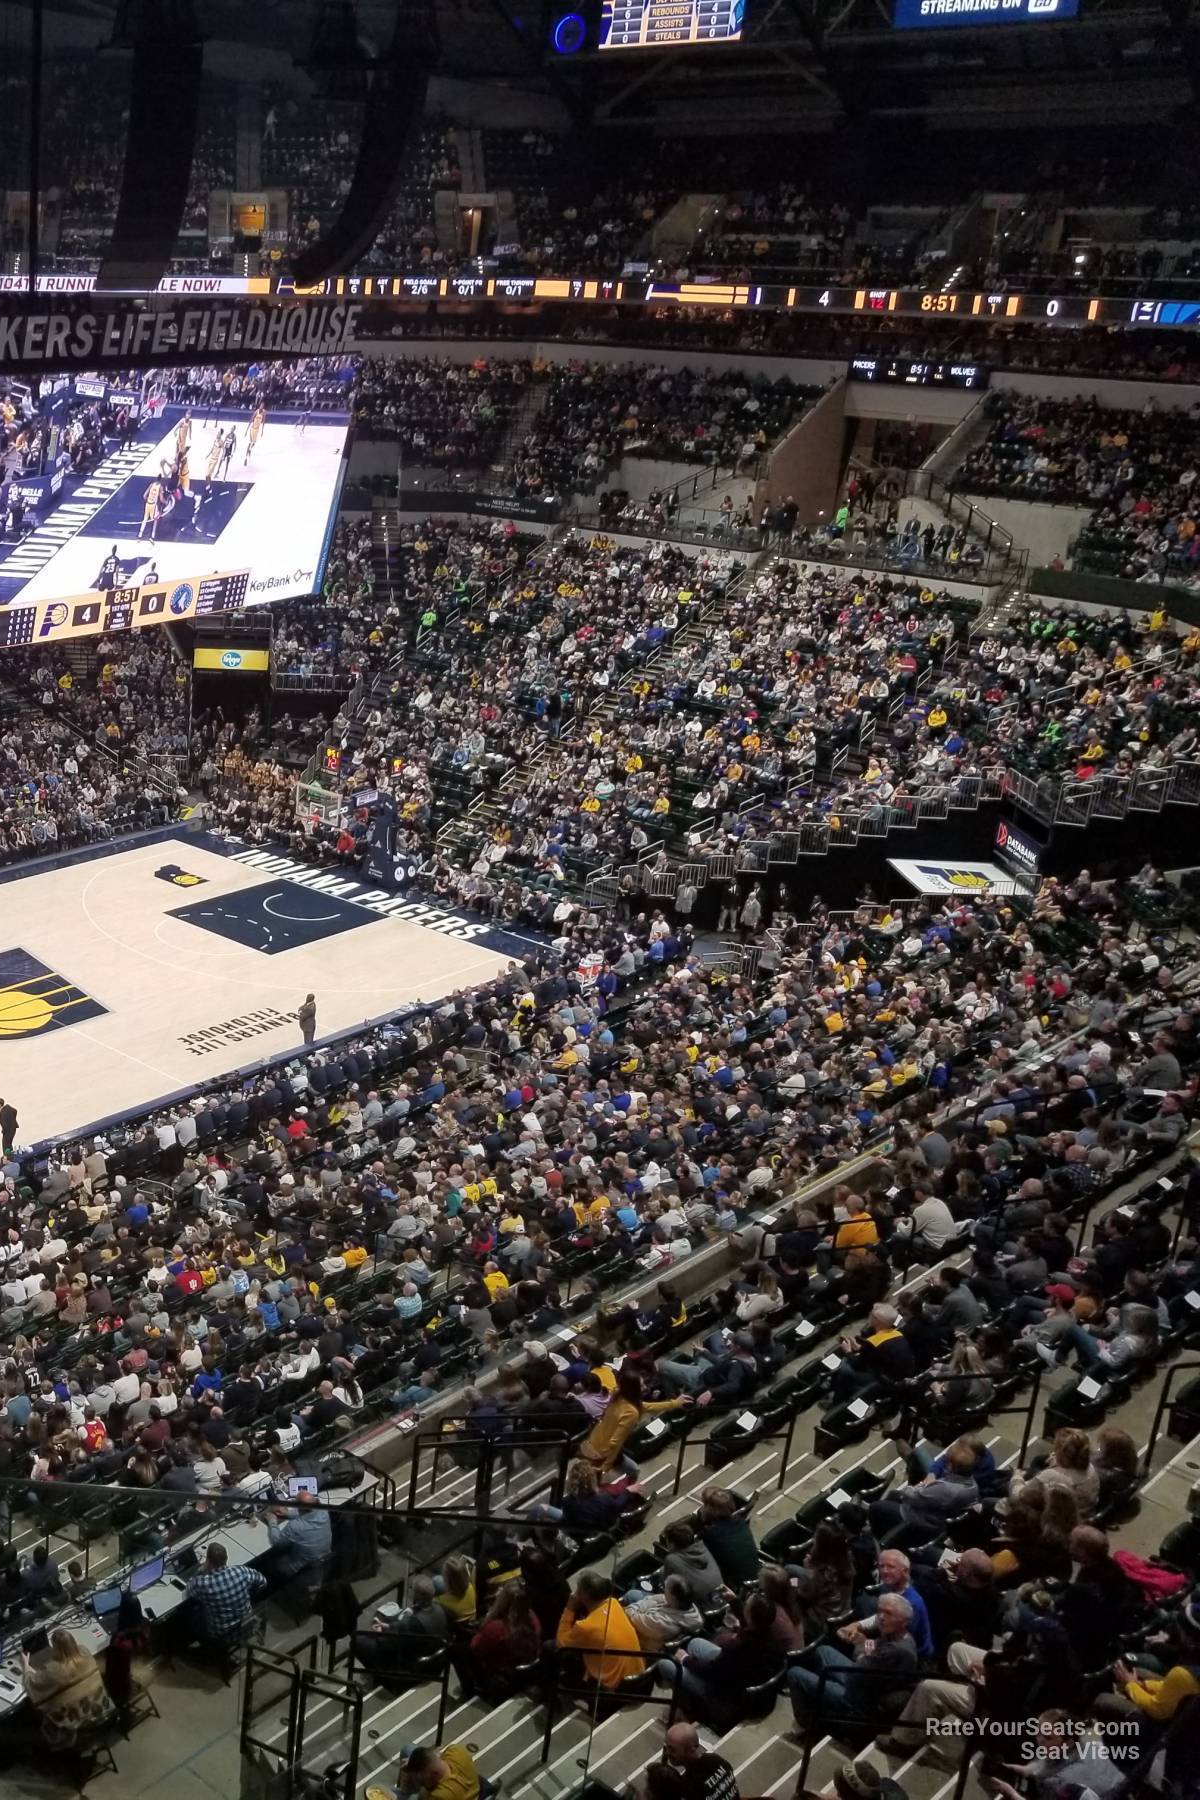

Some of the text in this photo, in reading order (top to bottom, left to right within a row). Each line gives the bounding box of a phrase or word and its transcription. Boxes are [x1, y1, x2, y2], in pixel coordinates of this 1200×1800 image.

[625, 4, 718, 19] 6 REBOUNDS 4
[921, 0, 999, 14] STREAMING
[655, 19, 684, 28] ASSISTS
[711, 16, 717, 25] 0
[622, 29, 715, 43] 0 STEALS 0
[182, 279, 221, 292] NOW!
[351, 286, 357, 294] 6
[411, 286, 428, 294] 2/6
[458, 286, 474, 295] 0/1
[506, 286, 521, 295] 0/1
[574, 288, 580, 297] 7
[819, 291, 830, 306] 4
[870, 299, 883, 309] 12
[921, 296, 956, 311] 8:51
[1047, 300, 1058, 316] 0
[102, 311, 176, 356] LIFE
[179, 305, 361, 353] FIELDHOUSE
[853, 361, 876, 369] PACERS
[951, 367, 975, 376] WOLVES
[72, 442, 156, 499] PACERS
[105, 564, 114, 573] 23
[250, 575, 291, 593] KeyBank
[114, 589, 136, 603] 8:51
[82, 609, 90, 622] 4
[148, 597, 157, 611] 0
[1007, 835, 1037, 864] DATABANK
[228, 849, 490, 939] INDIANA PACERS
[177, 1007, 280, 1045] FIELDHOUSE
[185, 1012, 301, 1056] BANKERS LIFE
[28, 1372, 40, 1388] 22
